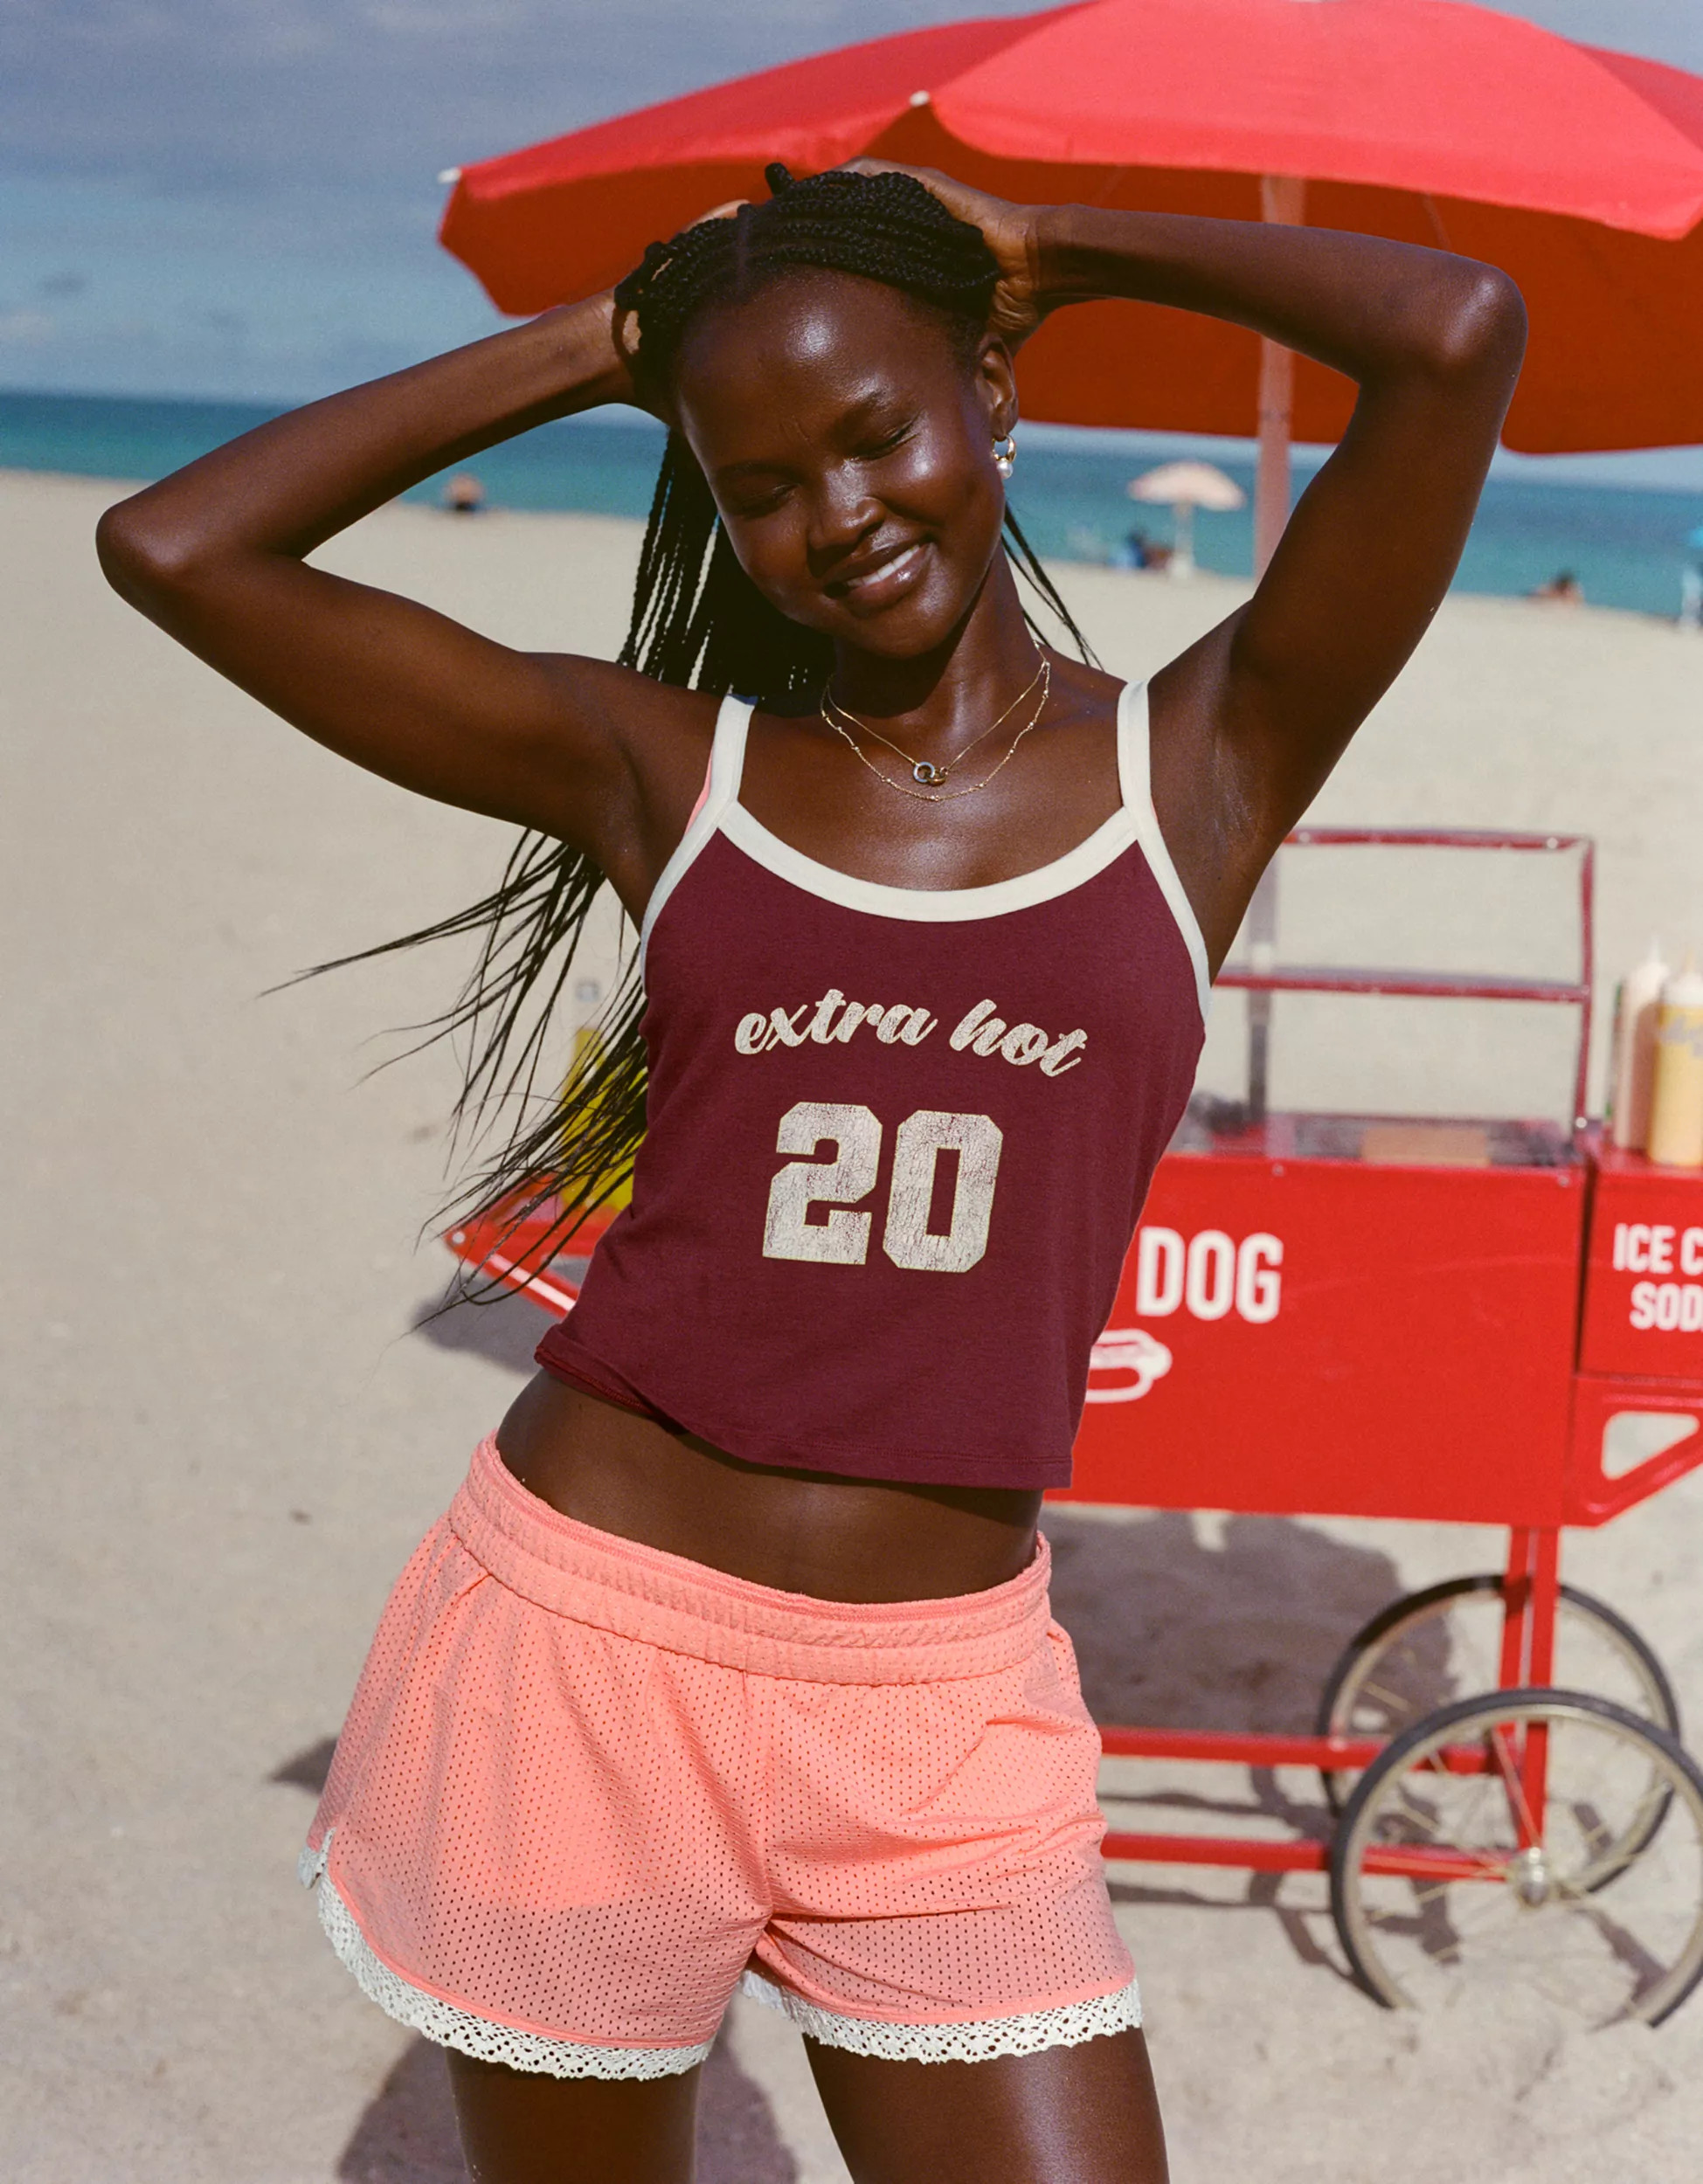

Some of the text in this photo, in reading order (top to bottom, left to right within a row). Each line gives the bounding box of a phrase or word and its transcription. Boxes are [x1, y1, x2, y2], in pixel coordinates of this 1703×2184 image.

[735, 989, 1088, 1077] extra hot
[763, 1102, 1003, 1273] 20
[1137, 1227, 1284, 1324] DOG
[1613, 1223, 1676, 1275] ICE
[1629, 1281, 1703, 1332] SOD
